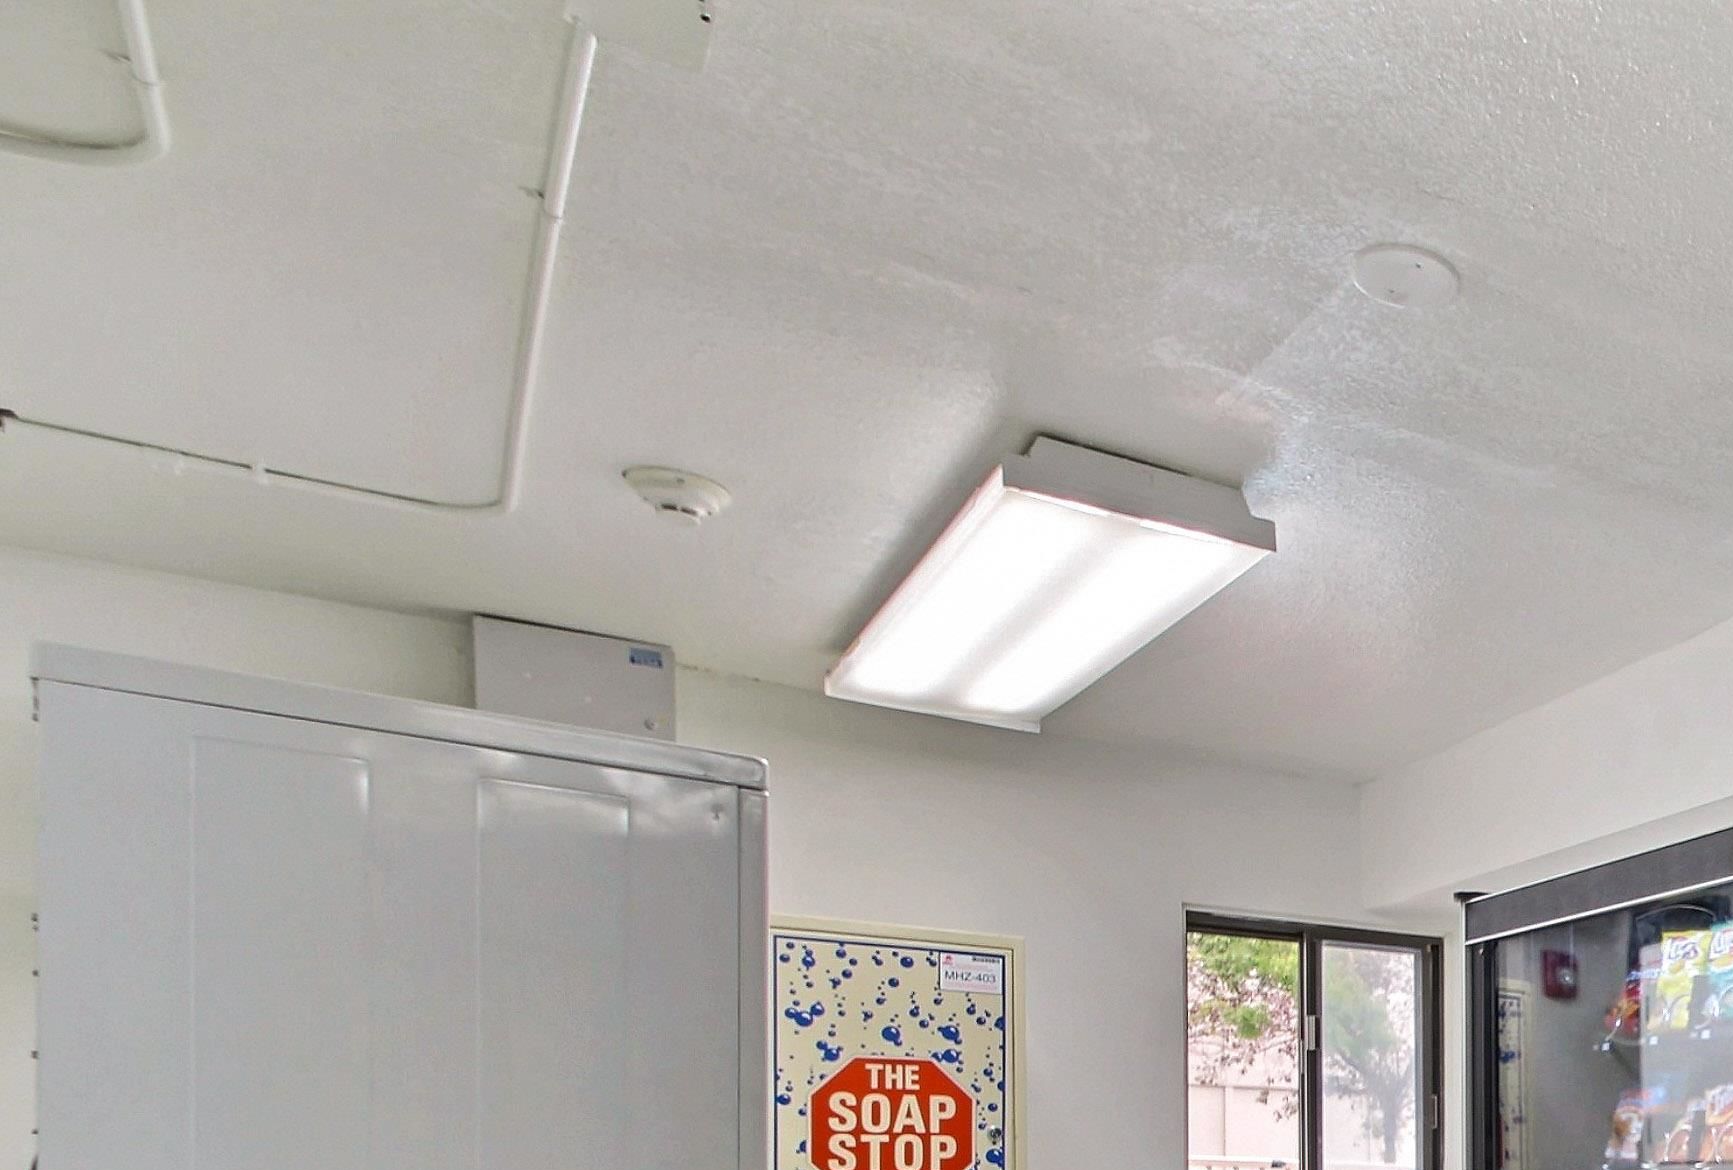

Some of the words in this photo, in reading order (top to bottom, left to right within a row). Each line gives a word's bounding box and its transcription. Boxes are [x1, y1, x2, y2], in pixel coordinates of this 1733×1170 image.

[945, 970, 996, 984] MHZ-403
[864, 1063, 920, 1091] THE
[828, 1091, 957, 1134] SOAP
